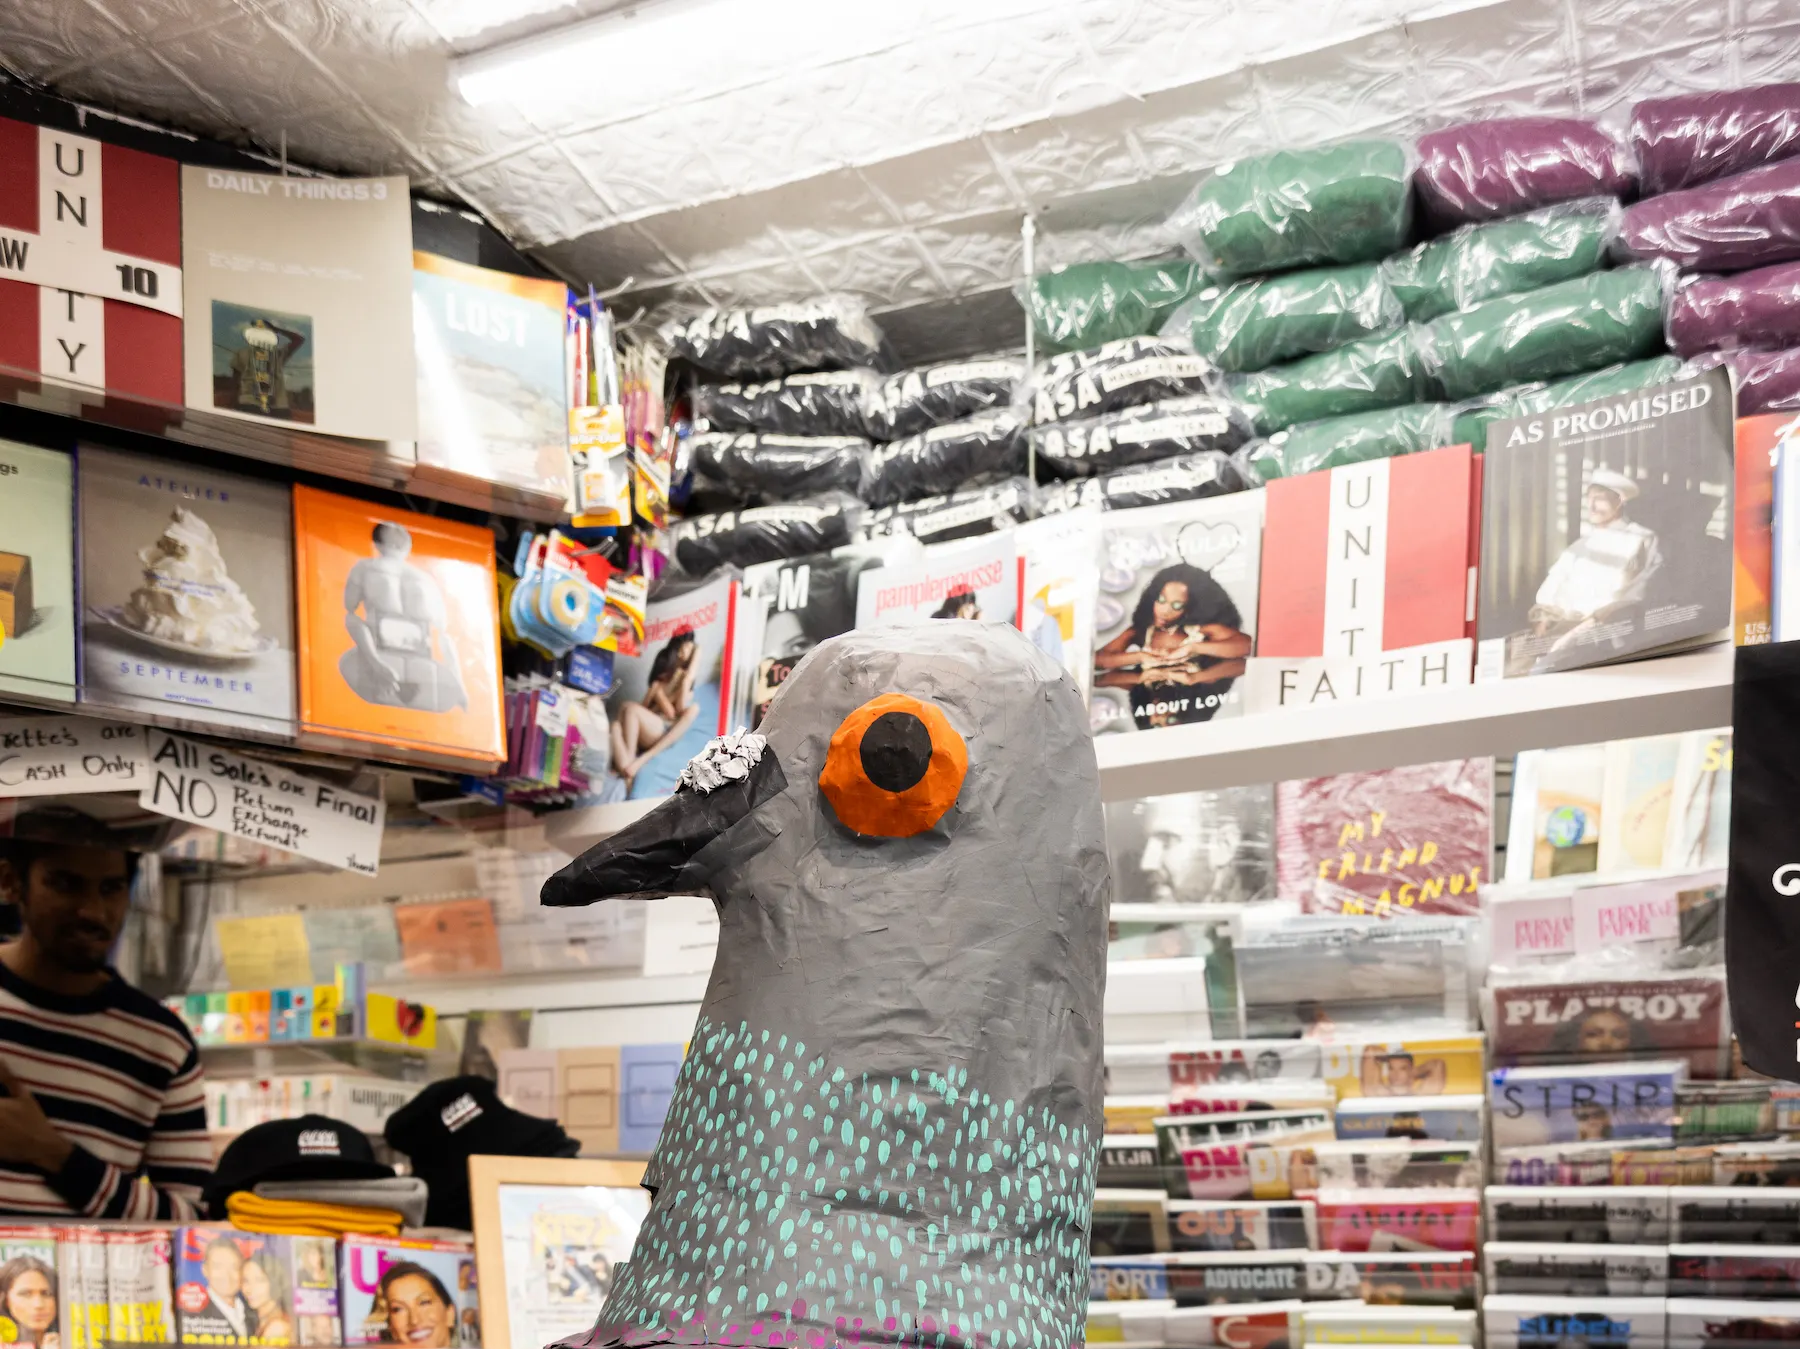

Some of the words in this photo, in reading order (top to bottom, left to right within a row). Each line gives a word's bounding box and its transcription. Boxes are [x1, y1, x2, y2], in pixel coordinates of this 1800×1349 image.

[207, 171, 272, 196] DAILY
[279, 181, 370, 200] THINGS
[372, 182, 387, 200] 3
[53, 142, 88, 374] UNTY
[115, 263, 158, 298] 10
[446, 292, 530, 348] LOST
[1506, 420, 1544, 448] AS
[1552, 384, 1713, 439] PROMISED
[138, 475, 230, 503] ATELIER
[875, 559, 1004, 618] pamplemousse
[120, 660, 255, 694] SEPTEMBER
[1279, 652, 1449, 707] FAITH
[1134, 698, 1190, 718] ABOUT
[1194, 692, 1241, 711] LOVE
[101, 725, 136, 741] are
[152, 769, 218, 819] NO
[153, 736, 200, 770] All
[314, 785, 378, 826] Final
[231, 806, 310, 839] Exchange
[1336, 811, 1388, 848] MY
[1317, 840, 1440, 882] FRIEND
[1340, 866, 1483, 917] MAGNUS
[1502, 1080, 1661, 1120] STRIP
[1177, 1209, 1261, 1237] OUT
[1204, 1266, 1298, 1290] ADVOCATE
